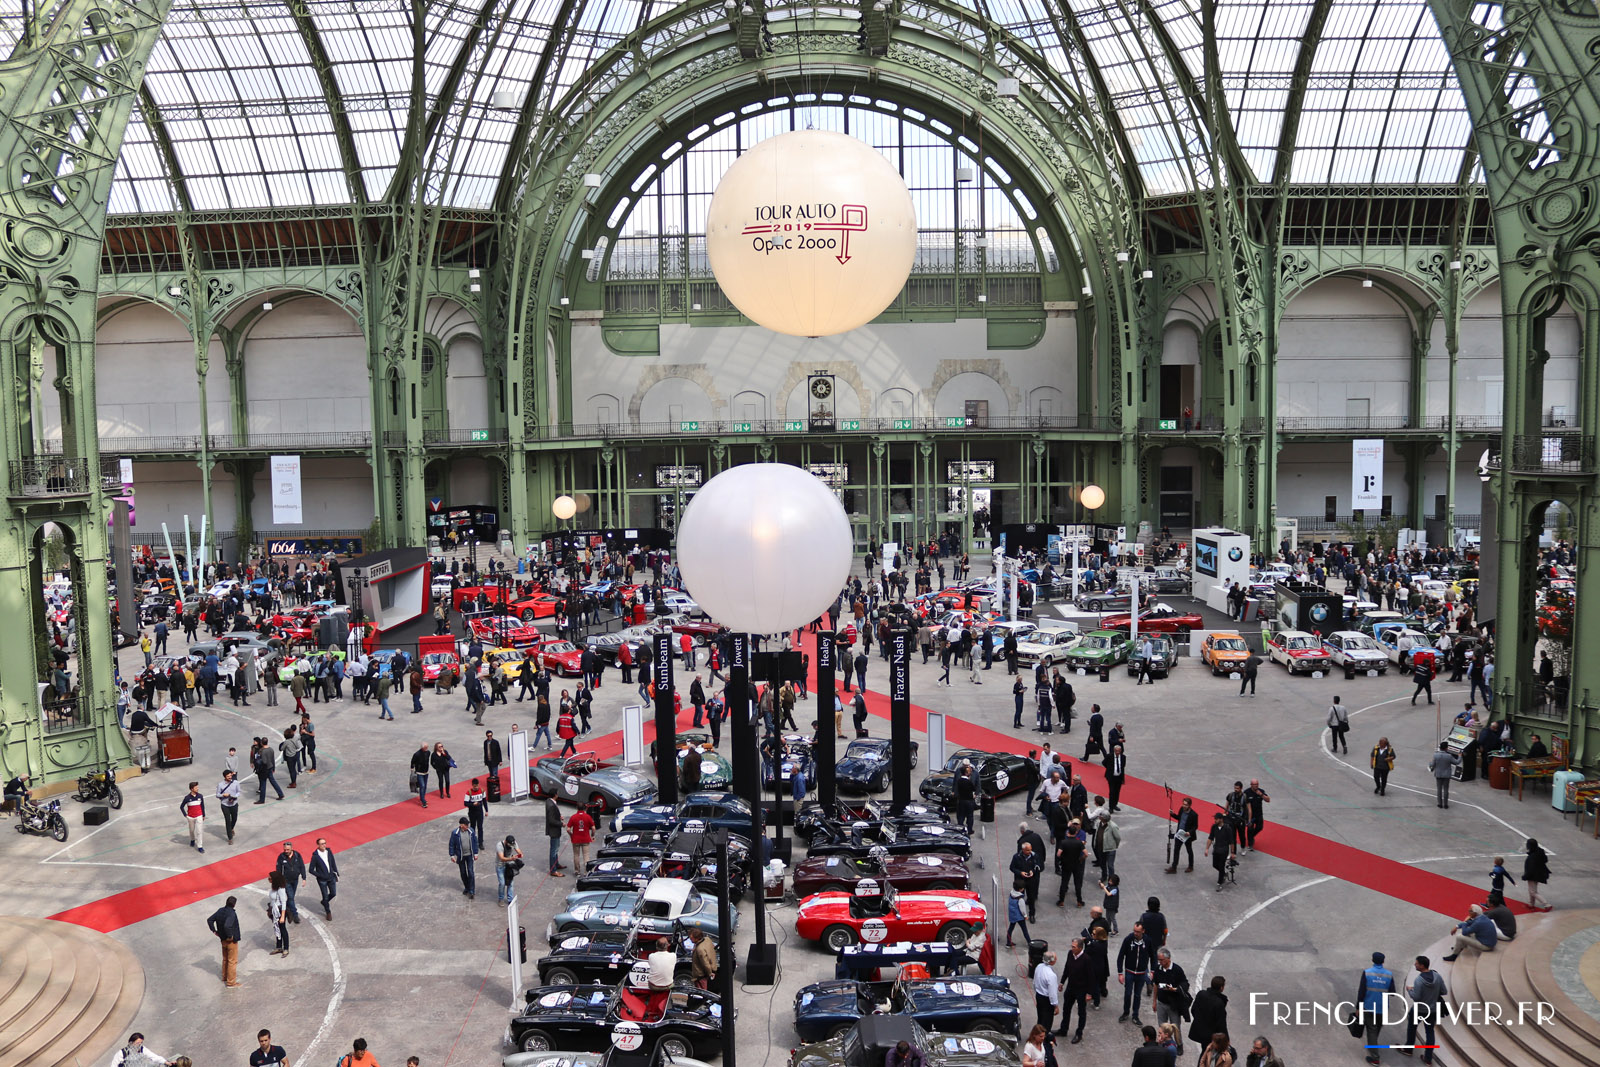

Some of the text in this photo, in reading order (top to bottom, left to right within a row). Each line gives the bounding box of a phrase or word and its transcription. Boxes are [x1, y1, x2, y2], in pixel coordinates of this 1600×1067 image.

[755, 204, 836, 220] TOUR AUTO
[774, 223, 812, 232] 2019
[753, 234, 836, 255] Opc 2000
[271, 541, 296, 554] 1664
[734, 638, 744, 668] Jowett
[820, 636, 830, 666] Healey
[658, 638, 668, 690] Sunbeam
[893, 636, 904, 701] Frazer Nash
[620, 1036, 634, 1044] 47
